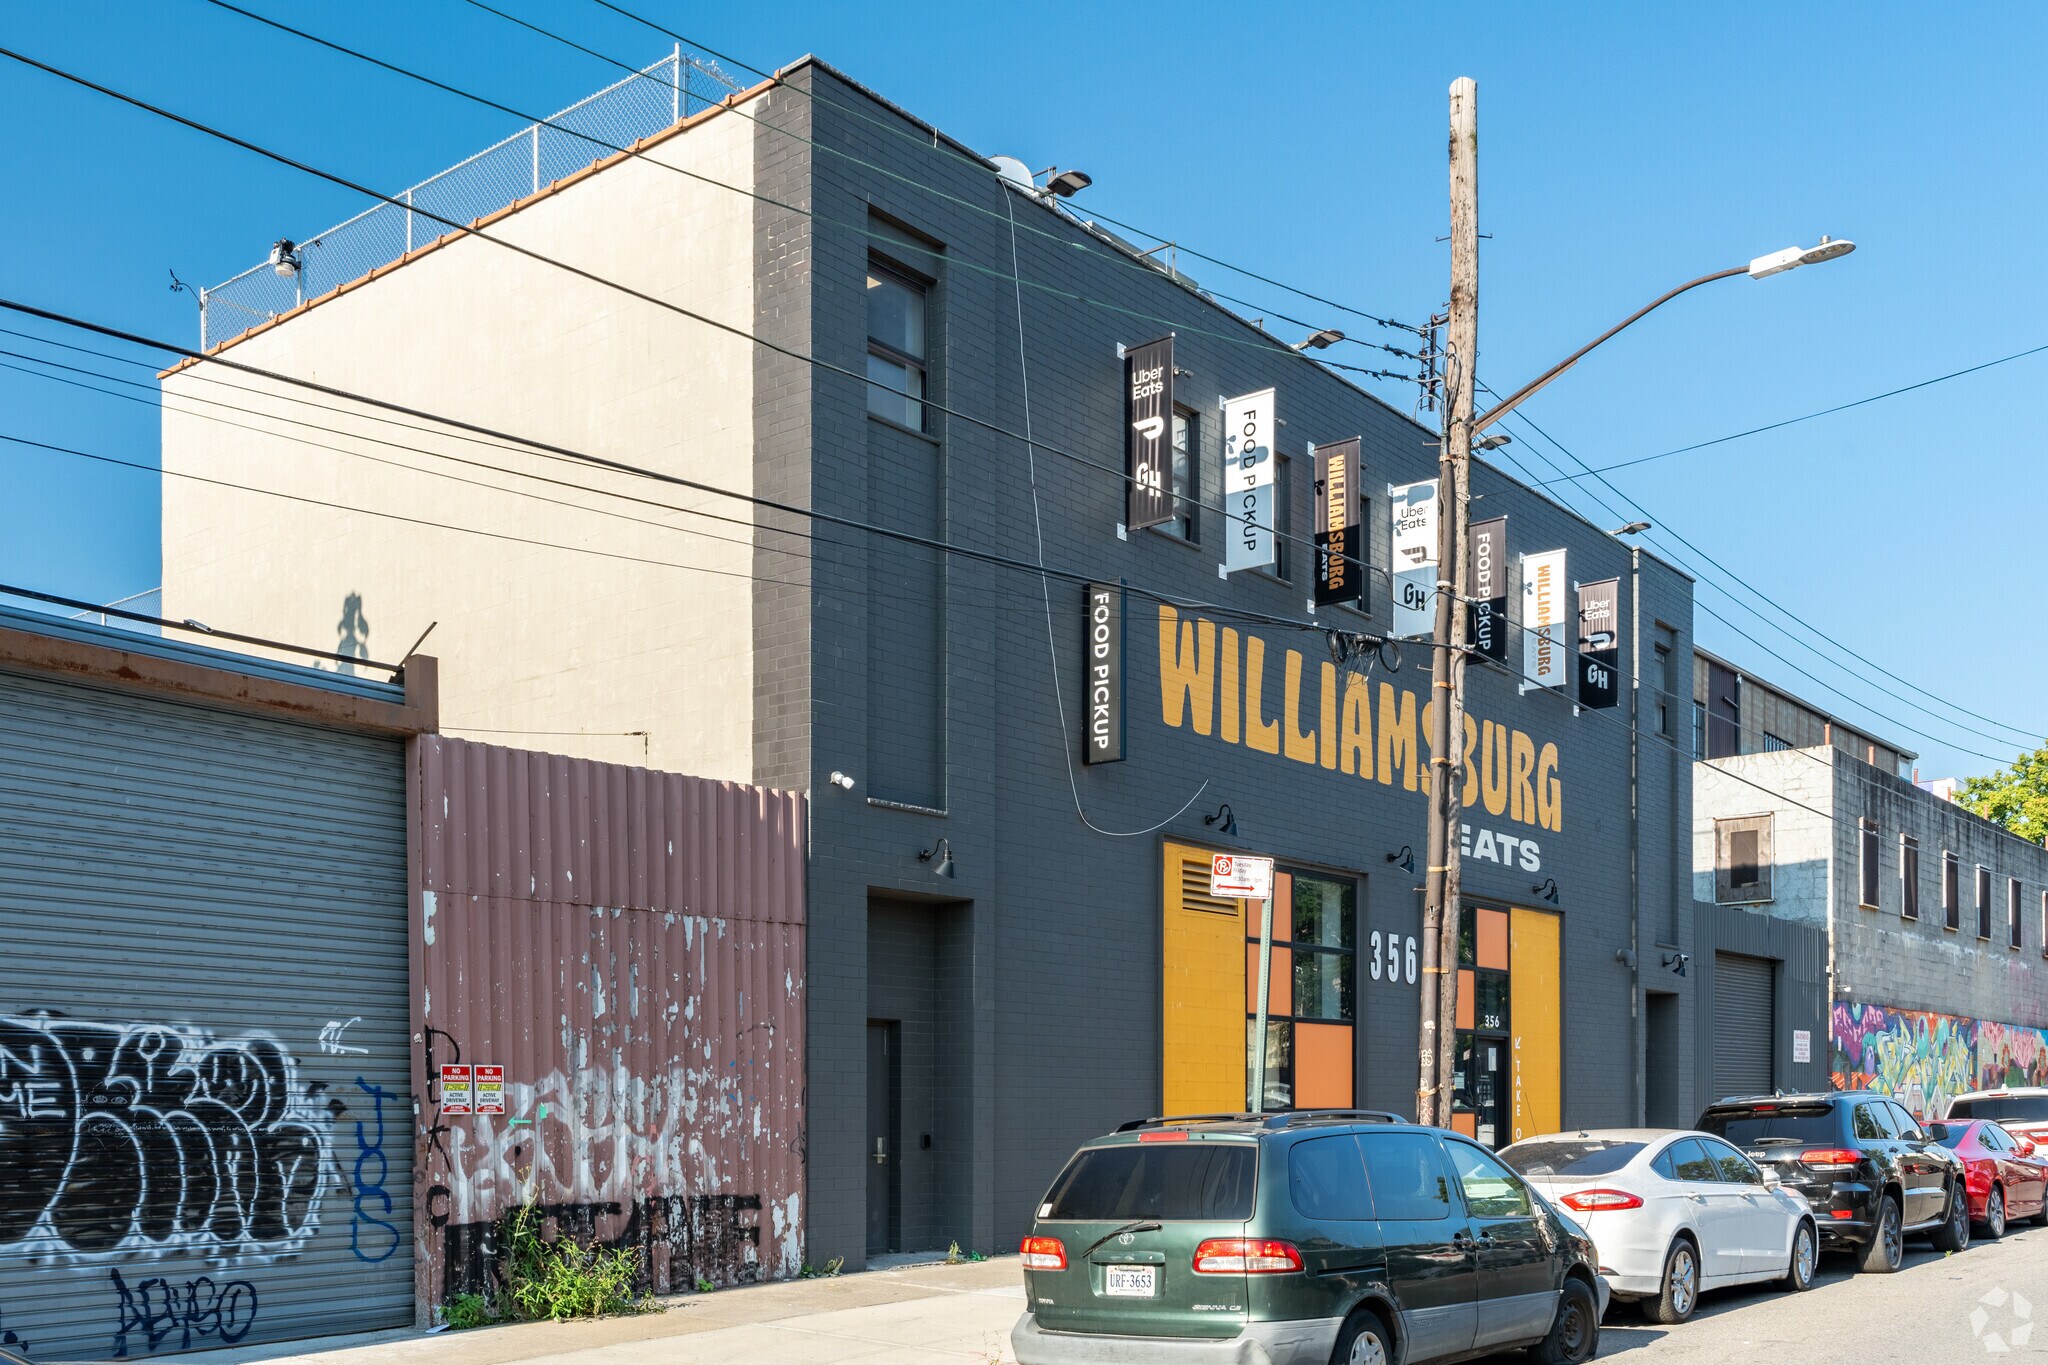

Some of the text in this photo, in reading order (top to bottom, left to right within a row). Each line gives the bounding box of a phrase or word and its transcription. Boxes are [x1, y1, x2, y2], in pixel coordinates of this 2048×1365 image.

[1133, 366, 1163, 385] Uber
[1133, 381, 1163, 400] Eats
[1243, 409, 1256, 551] FOOD PICKUP
[1328, 454, 1345, 590] WILLIAMSBURG
[1401, 505, 1427, 520] Uber
[1401, 517, 1427, 531] Eats
[1477, 532, 1491, 650] FOOD PICKUP
[1585, 598, 1610, 611] Uber
[1537, 564, 1552, 677] WILLIAMSBURG
[1585, 608, 1610, 621] Eats
[1094, 593, 1110, 749] FOOD PICKUP
[1370, 930, 1417, 985] 356
[1484, 1014, 1500, 1028] 356
[1748, 1150, 1766, 1158] Jeep
[1110, 1273, 1152, 1288] URF-3653
